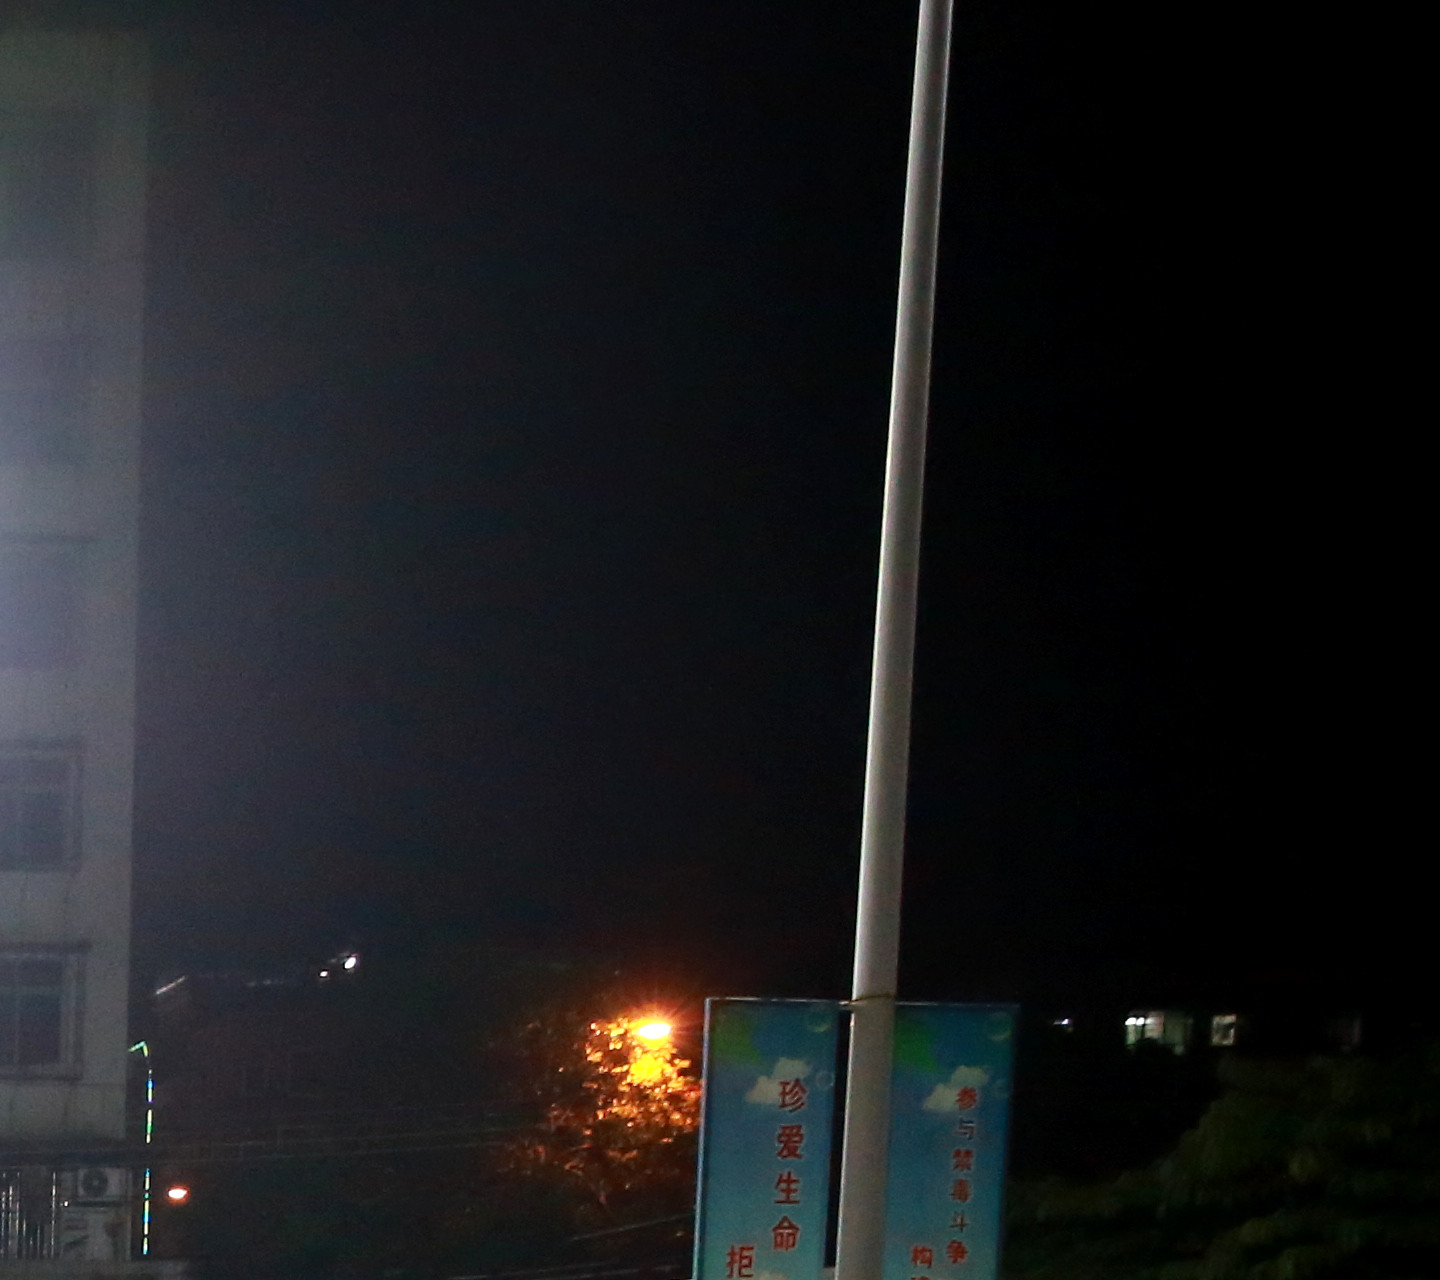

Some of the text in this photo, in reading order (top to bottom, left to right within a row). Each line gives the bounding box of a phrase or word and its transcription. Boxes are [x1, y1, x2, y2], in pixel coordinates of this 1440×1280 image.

[772, 1079, 807, 1253] 珍爱生命
[946, 1087, 978, 1265] 参与禁毒斗争
